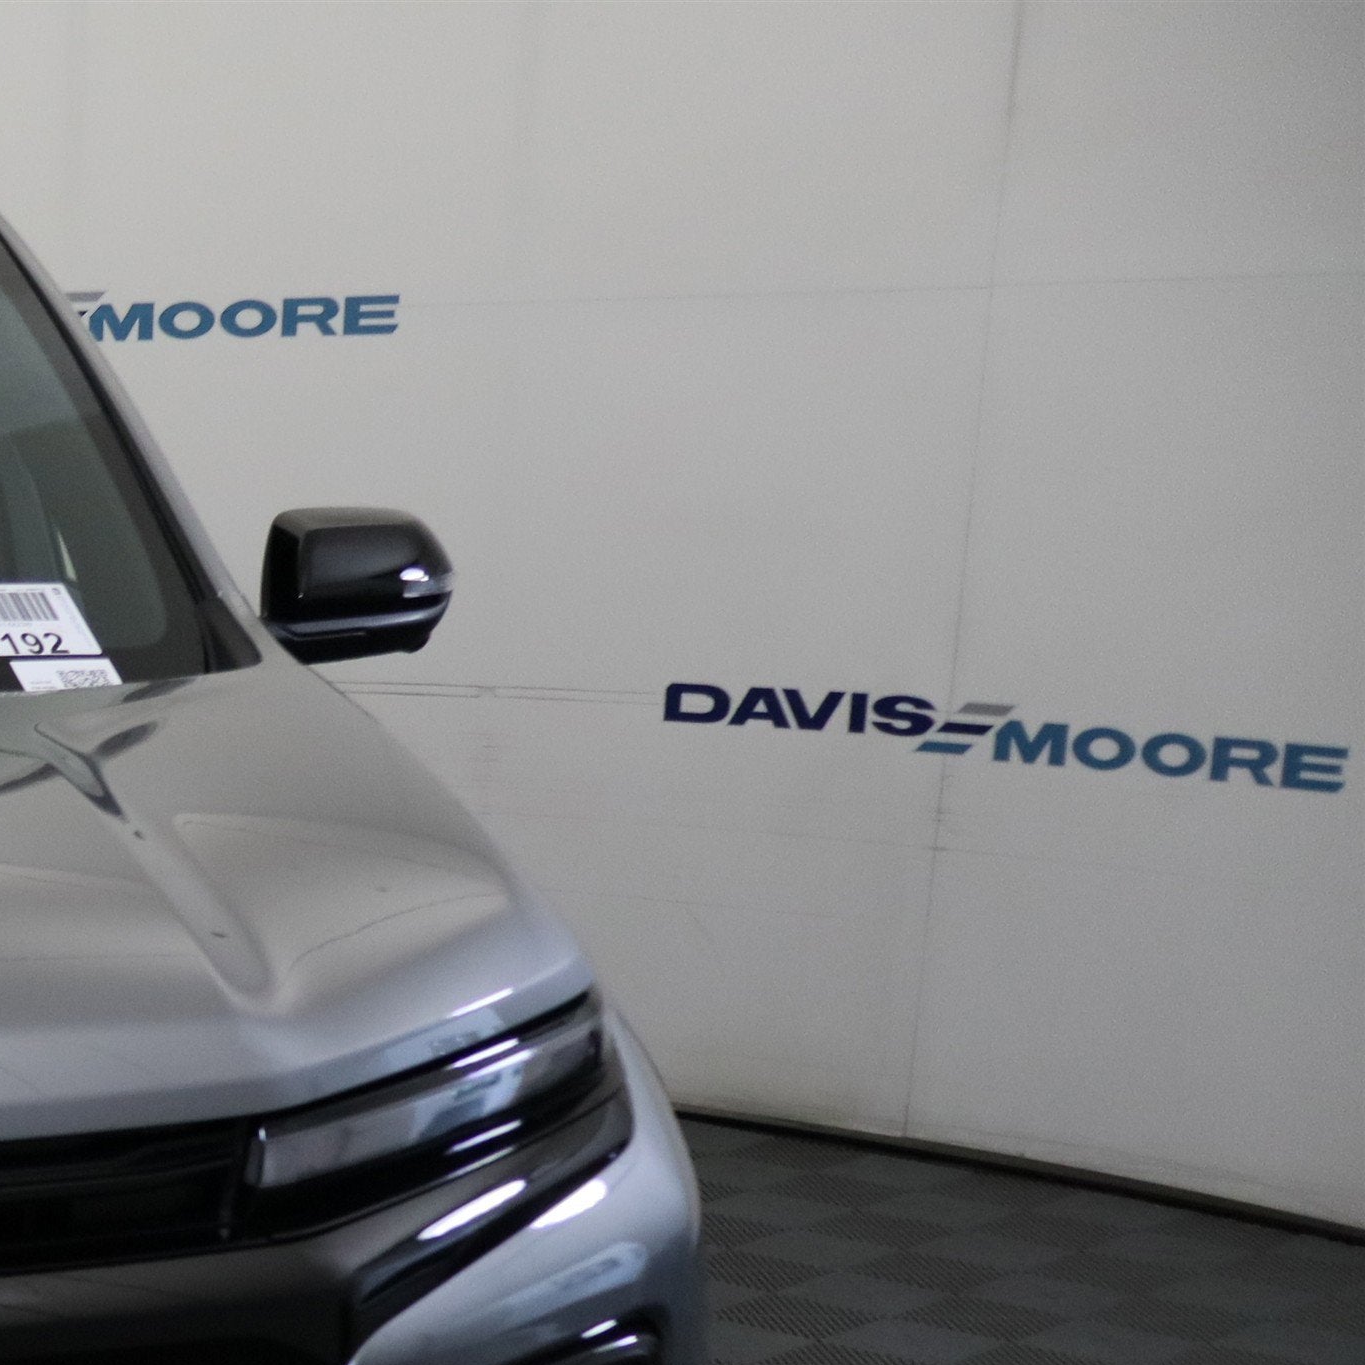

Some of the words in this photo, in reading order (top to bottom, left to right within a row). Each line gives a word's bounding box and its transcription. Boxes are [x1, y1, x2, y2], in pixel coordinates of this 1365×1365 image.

[88, 294, 401, 342] MOORE
[663, 682, 938, 737] DAVIS
[992, 720, 1350, 793] MOORE
